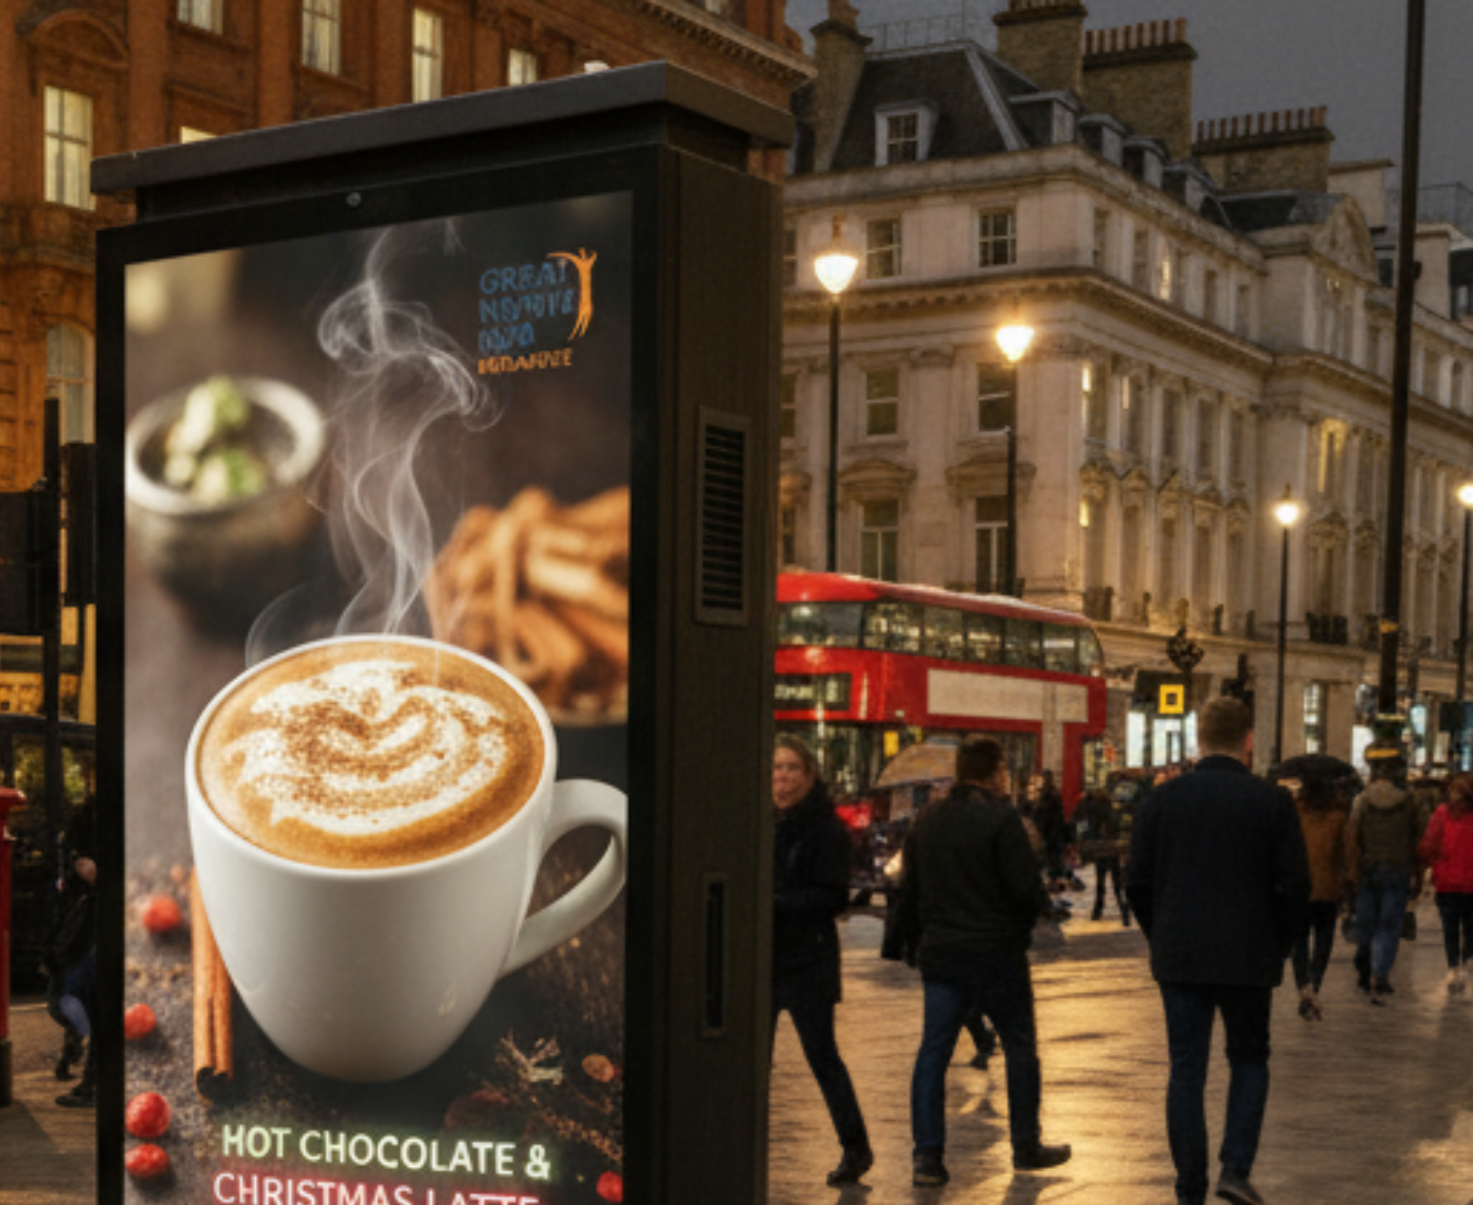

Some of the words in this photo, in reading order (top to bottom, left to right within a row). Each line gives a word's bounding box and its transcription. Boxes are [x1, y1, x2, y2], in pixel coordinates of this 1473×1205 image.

[222, 1124, 291, 1158] HOT
[299, 1130, 516, 1175] CHOCOLATE
[524, 1144, 551, 1180] &
